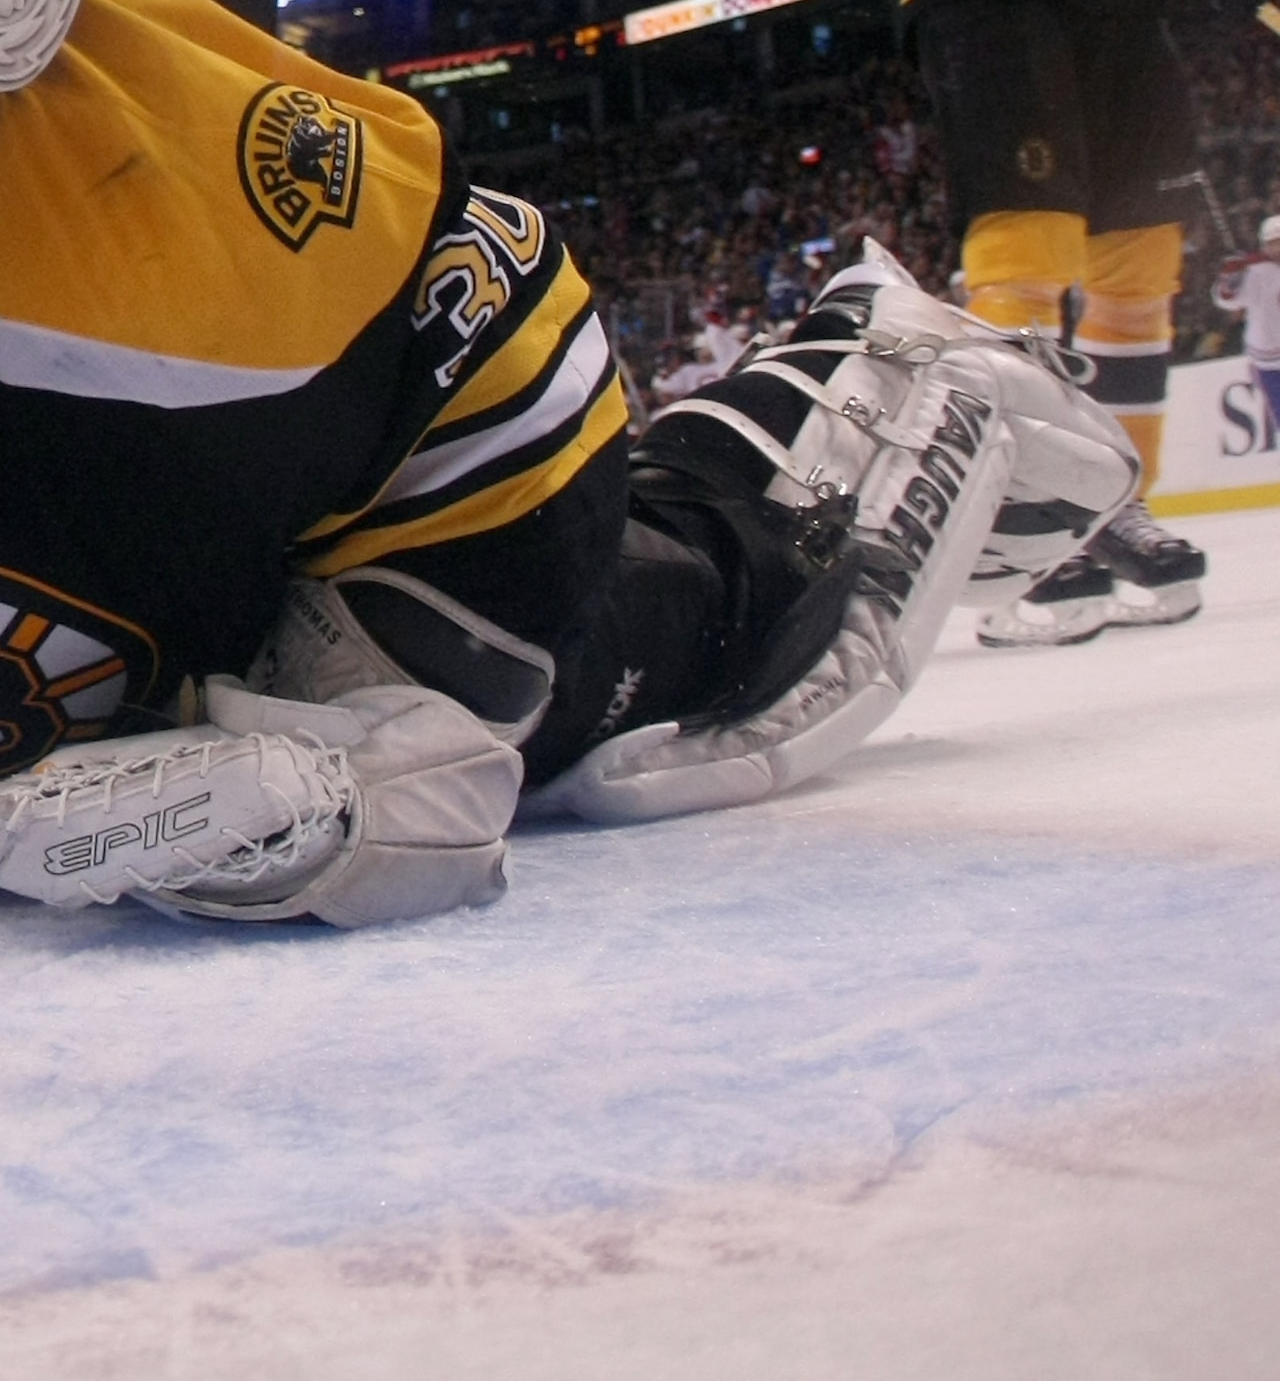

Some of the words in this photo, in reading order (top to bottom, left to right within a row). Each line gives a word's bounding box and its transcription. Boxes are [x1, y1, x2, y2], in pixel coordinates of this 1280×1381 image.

[253, 90, 322, 228] BRUINS
[329, 125, 349, 197] BOSTON
[411, 183, 547, 389] 30
[43, 791, 211, 876] EPIC
